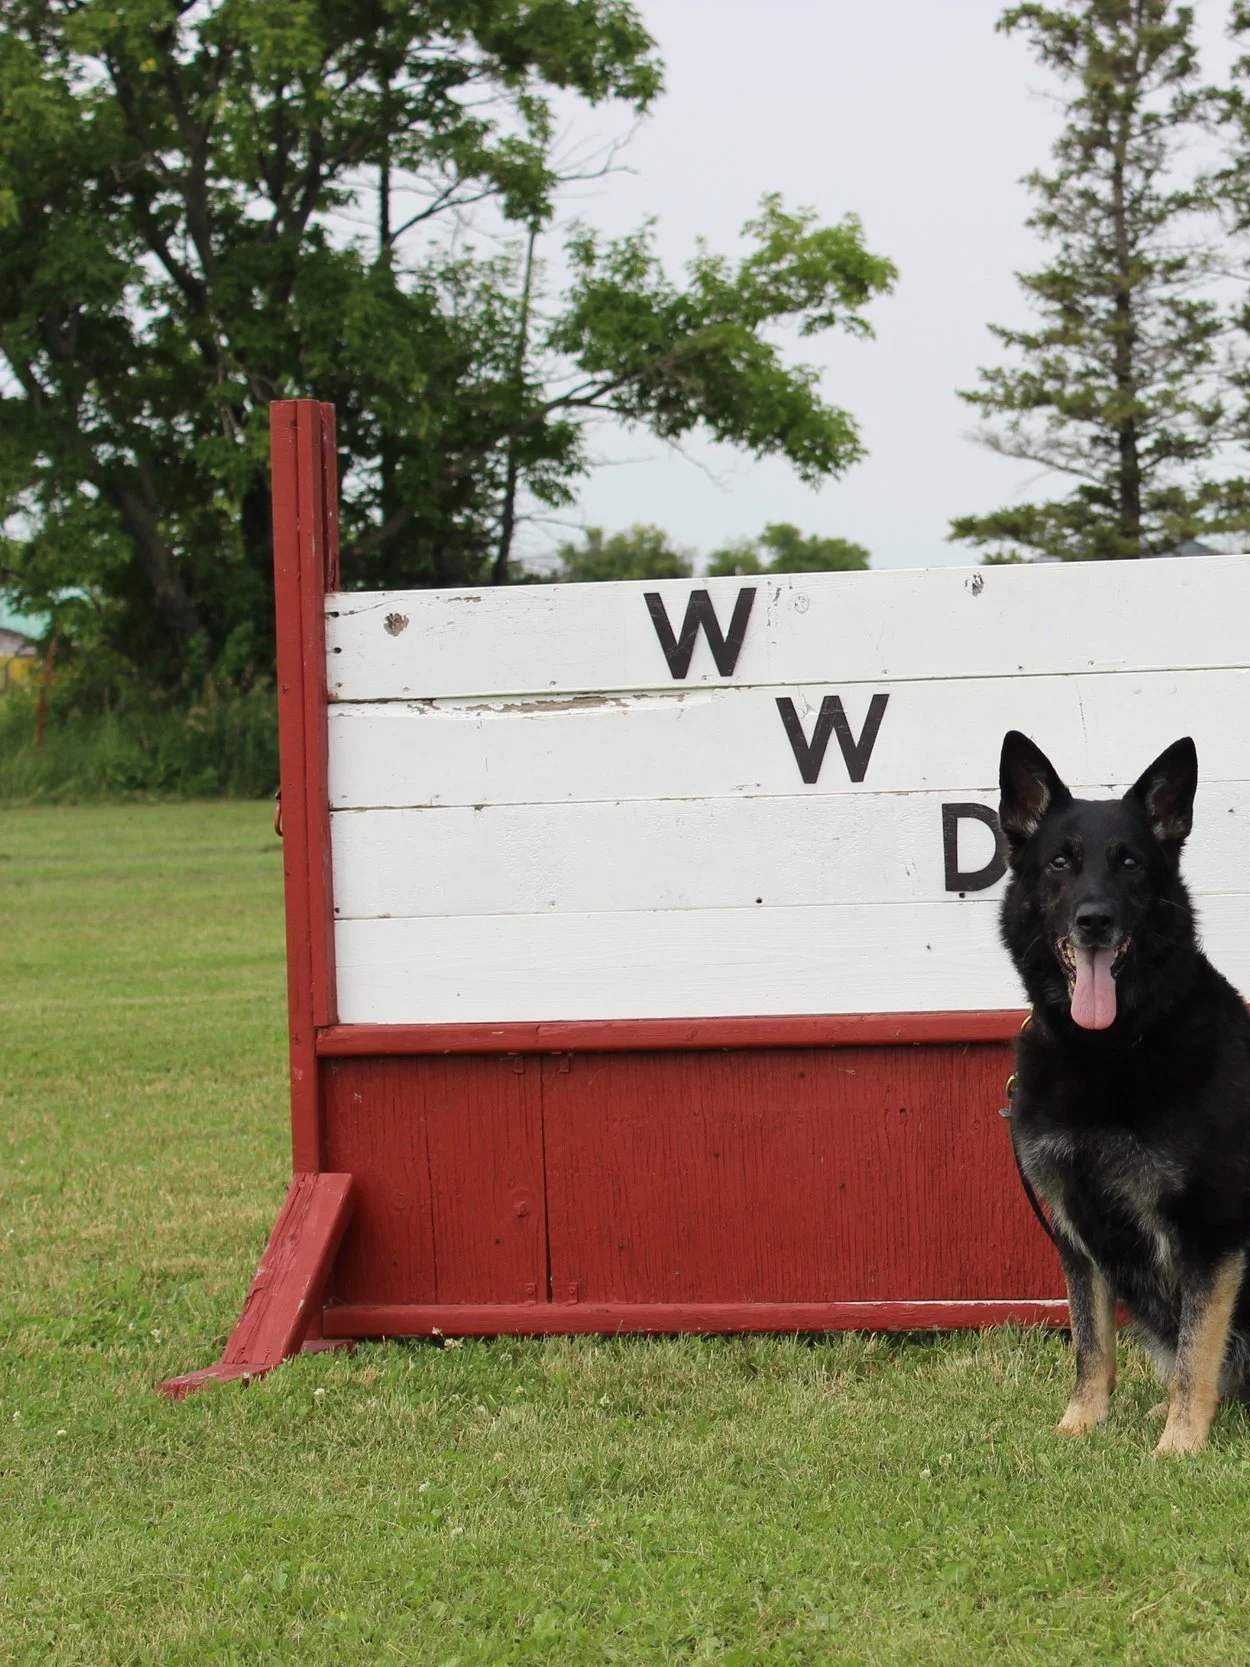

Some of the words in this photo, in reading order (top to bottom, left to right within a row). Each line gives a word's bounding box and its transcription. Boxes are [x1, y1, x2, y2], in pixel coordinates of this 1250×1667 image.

[643, 587, 757, 680] W
[775, 693, 890, 785] W
[942, 802, 1007, 892] D
